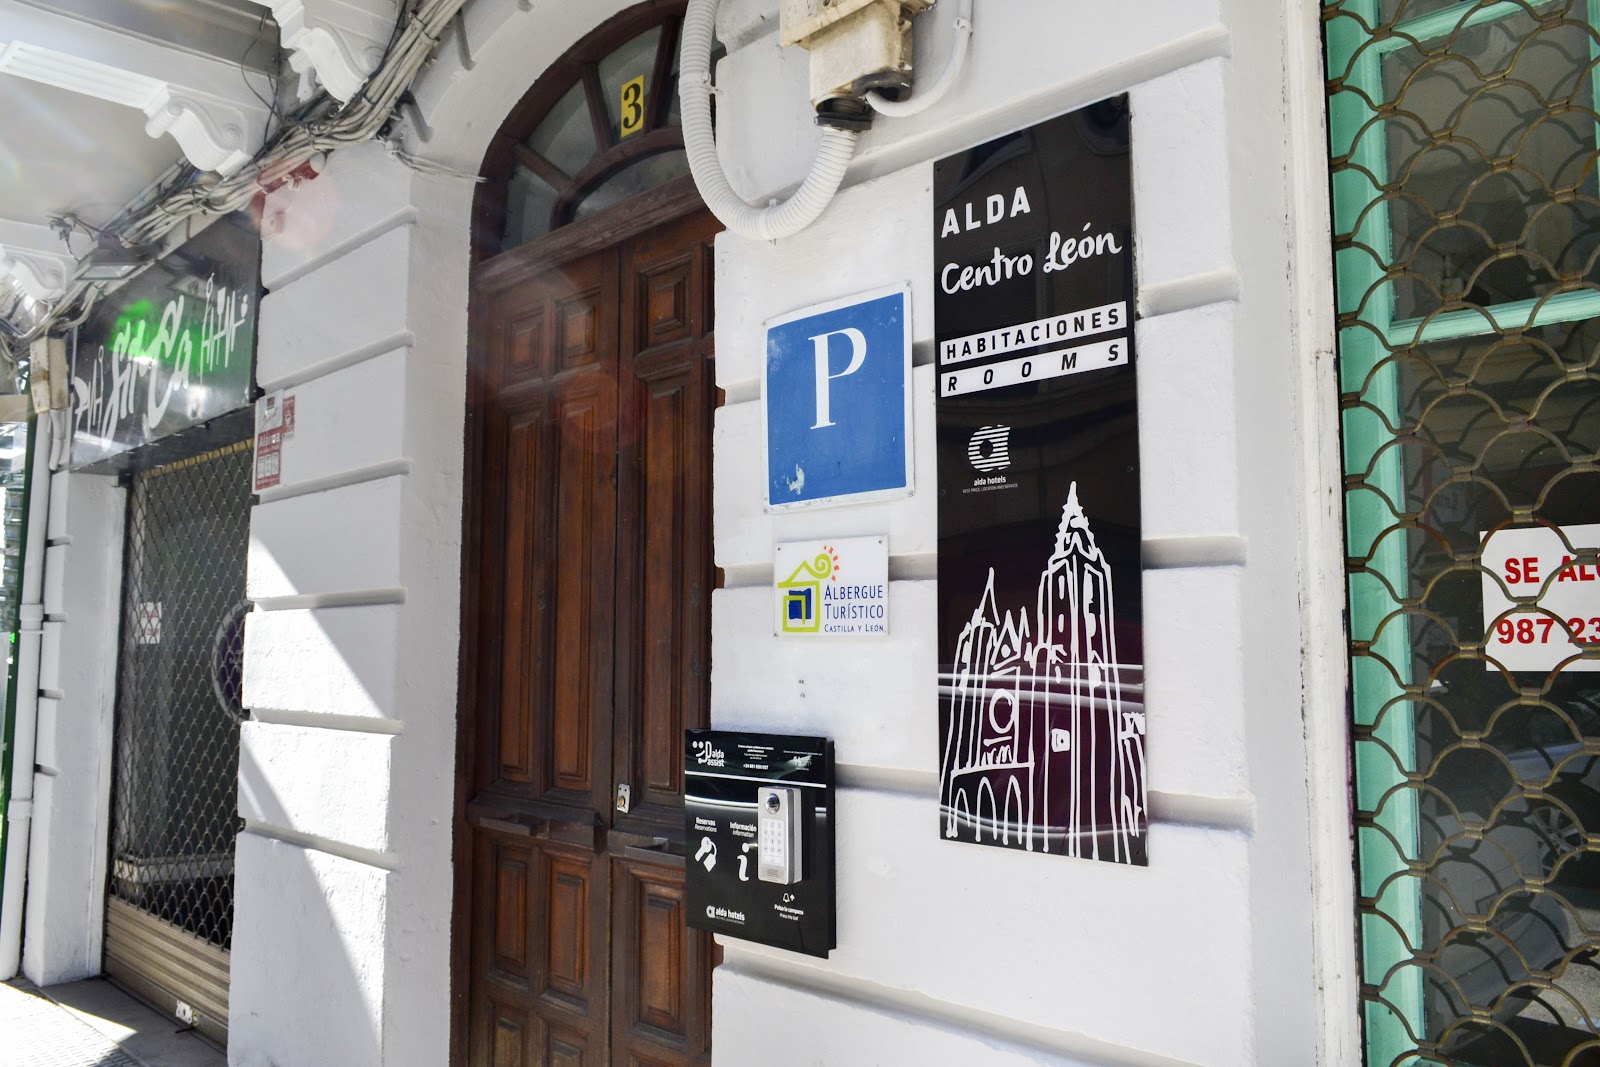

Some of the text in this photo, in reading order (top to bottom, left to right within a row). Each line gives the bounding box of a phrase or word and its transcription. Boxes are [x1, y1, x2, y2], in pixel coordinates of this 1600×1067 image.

[623, 83, 642, 129] 3
[941, 186, 1031, 238] ALDA
[941, 222, 1123, 294] Centro León
[946, 308, 1119, 360] HABITACIONES
[808, 327, 867, 430] P
[973, 475, 1006, 487] alda hotels
[1505, 555, 1600, 584] SE AL
[824, 584, 883, 600] ALBERGUE
[824, 603, 884, 619] TURÍSTICO
[824, 624, 854, 632] CASTILLA
[1496, 618, 1554, 645] 987
[706, 758, 725, 768] assist
[694, 824, 717, 833] Reservations
[695, 817, 716, 826] Reservas
[729, 822, 757, 832] Información
[732, 830, 755, 838] Information
[715, 907, 727, 917] alda
[727, 908, 746, 921] hotels
